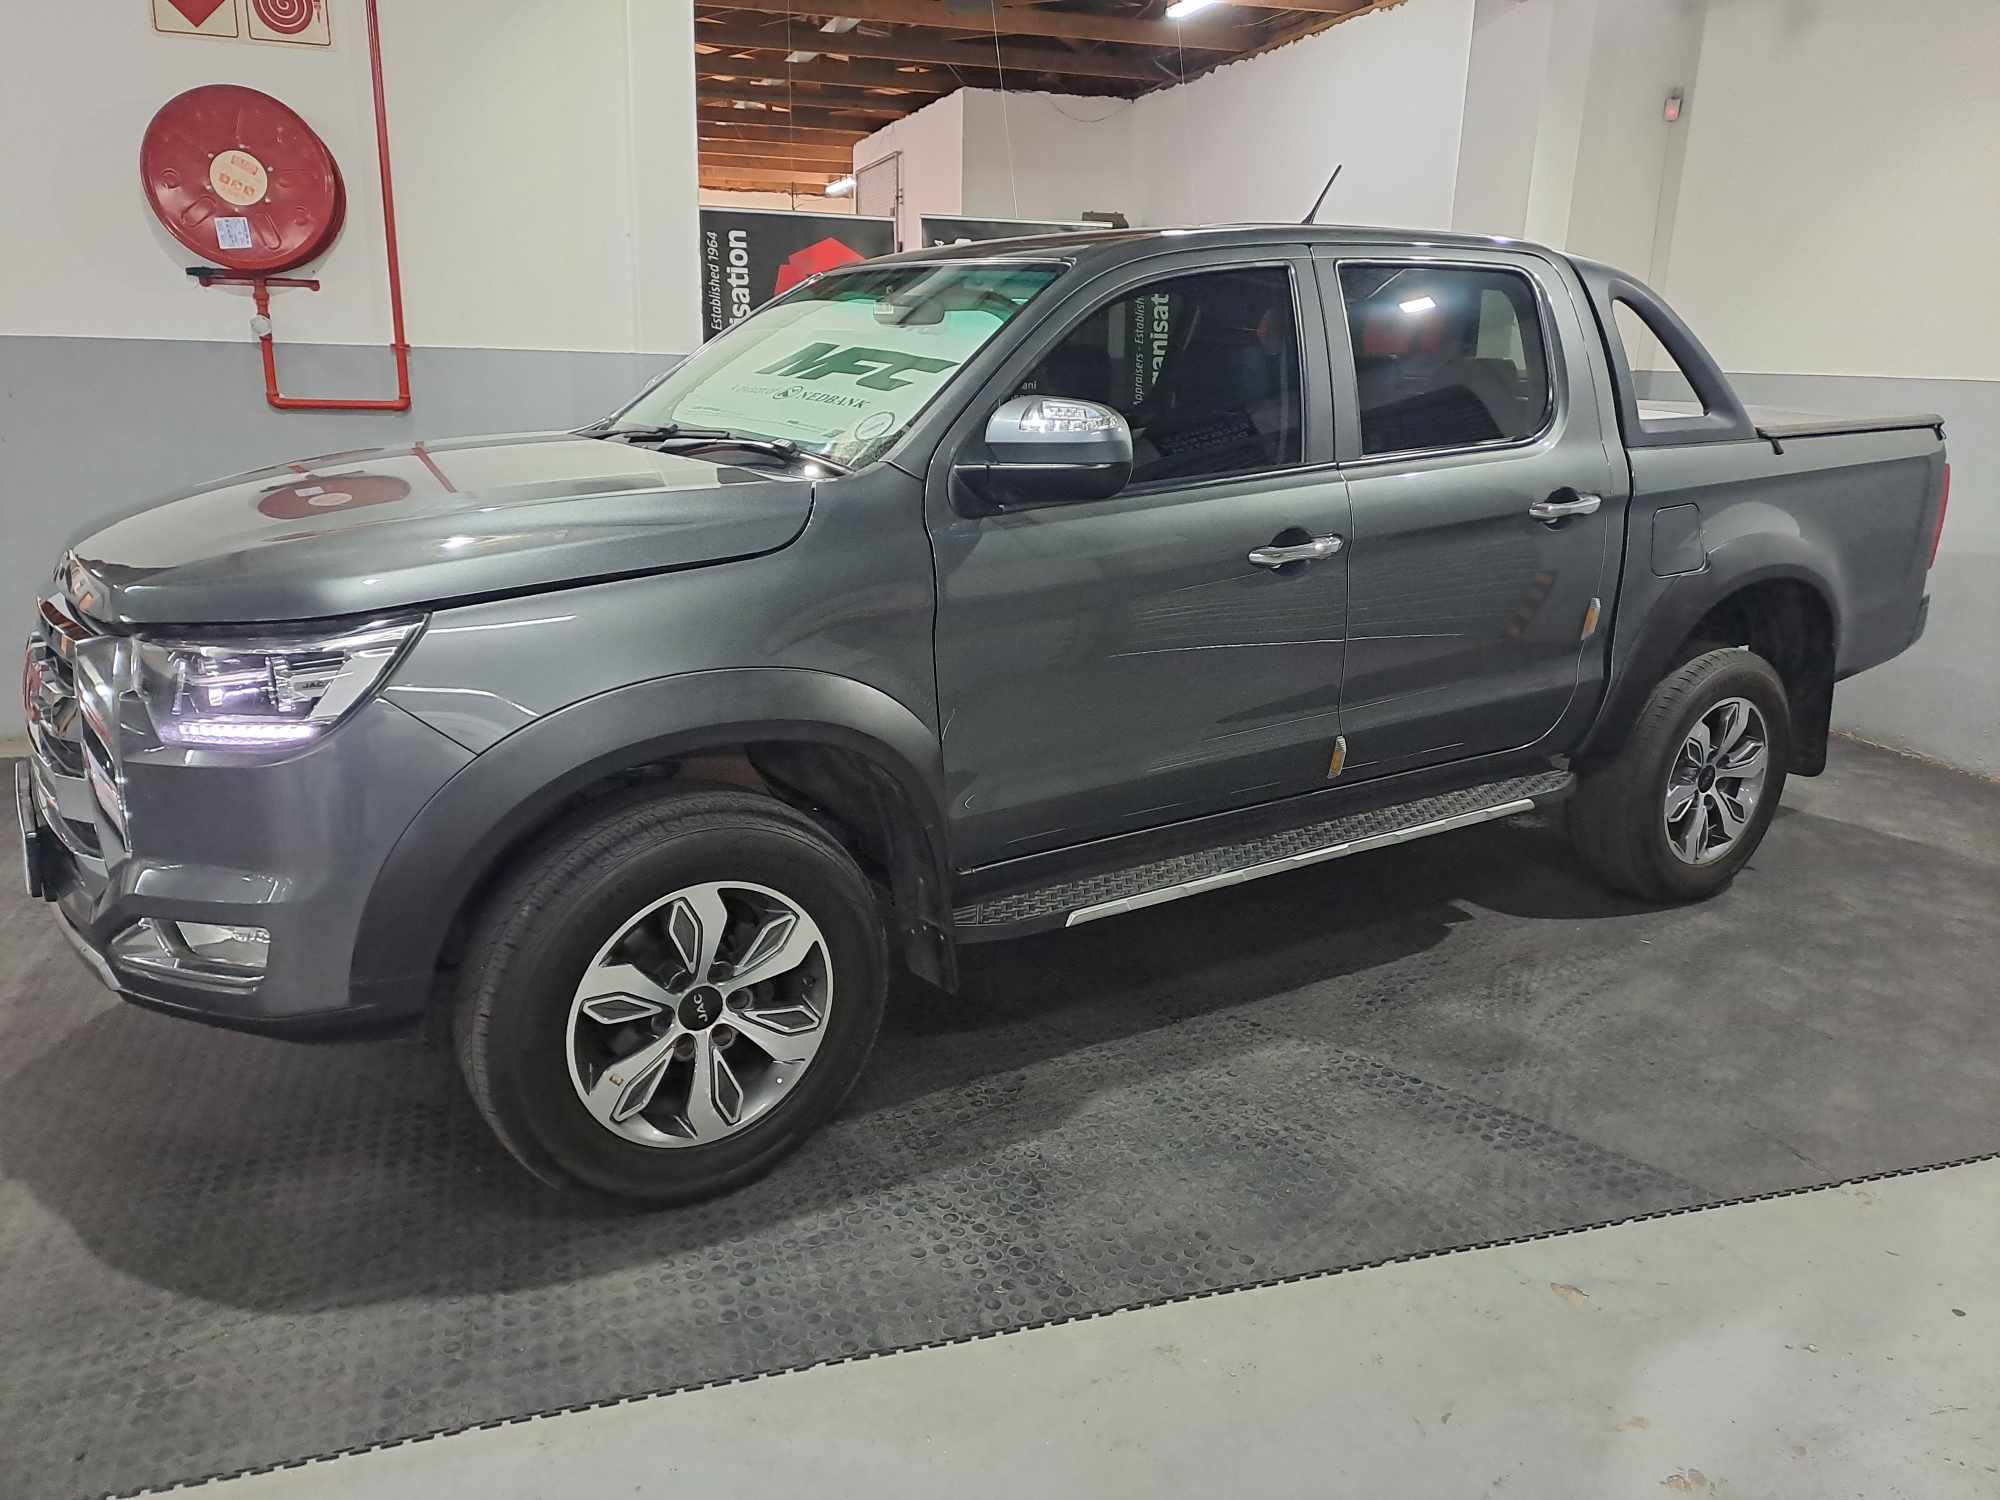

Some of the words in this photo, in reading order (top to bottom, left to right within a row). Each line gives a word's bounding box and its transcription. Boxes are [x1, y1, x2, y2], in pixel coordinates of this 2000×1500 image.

[706, 231, 720, 260] 1964
[708, 263, 723, 330] Established
[1149, 293, 1170, 385] anisat
[799, 391, 869, 409] NEDBANK
[693, 993, 708, 1022] JAC
